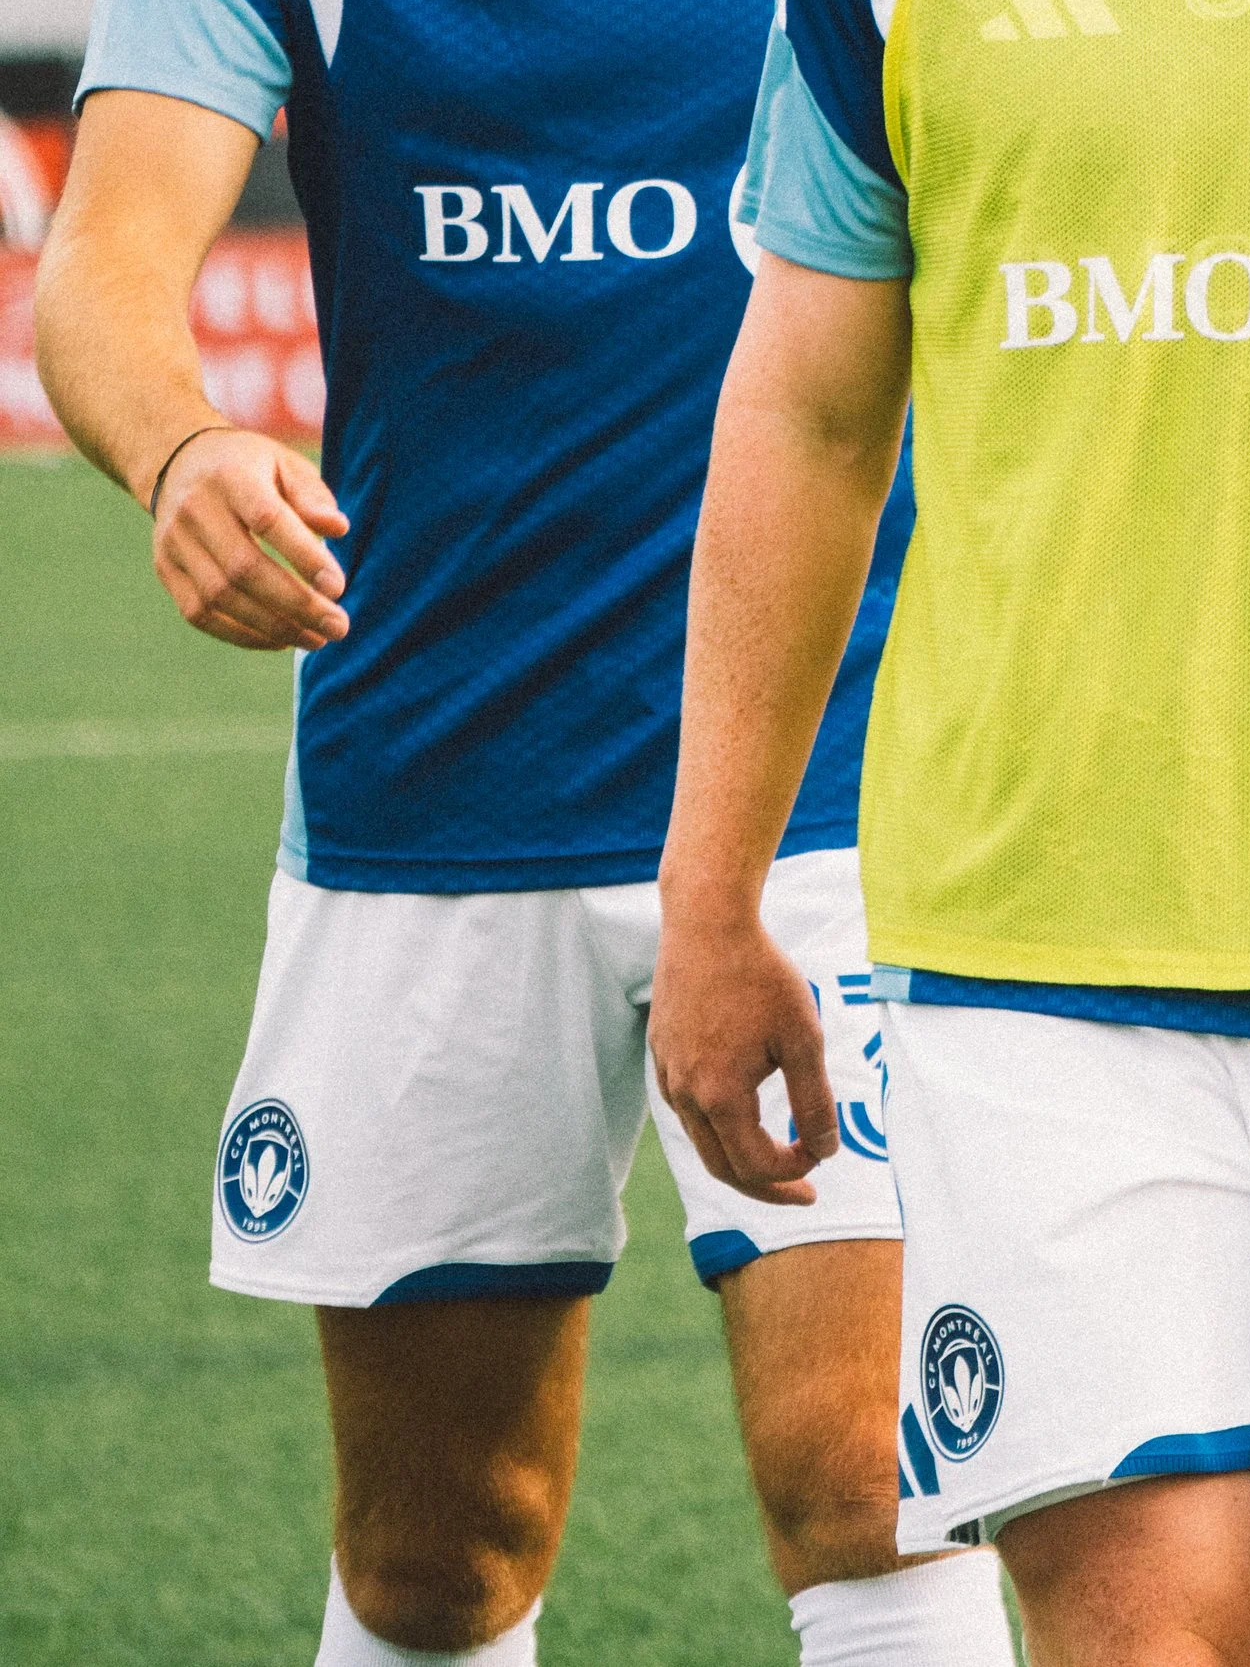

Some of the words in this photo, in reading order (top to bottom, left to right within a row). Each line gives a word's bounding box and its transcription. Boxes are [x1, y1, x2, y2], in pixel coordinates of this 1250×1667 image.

[413, 178, 698, 264] BMO
[230, 1135, 245, 1160] CF
[928, 1363, 937, 1390] CF
